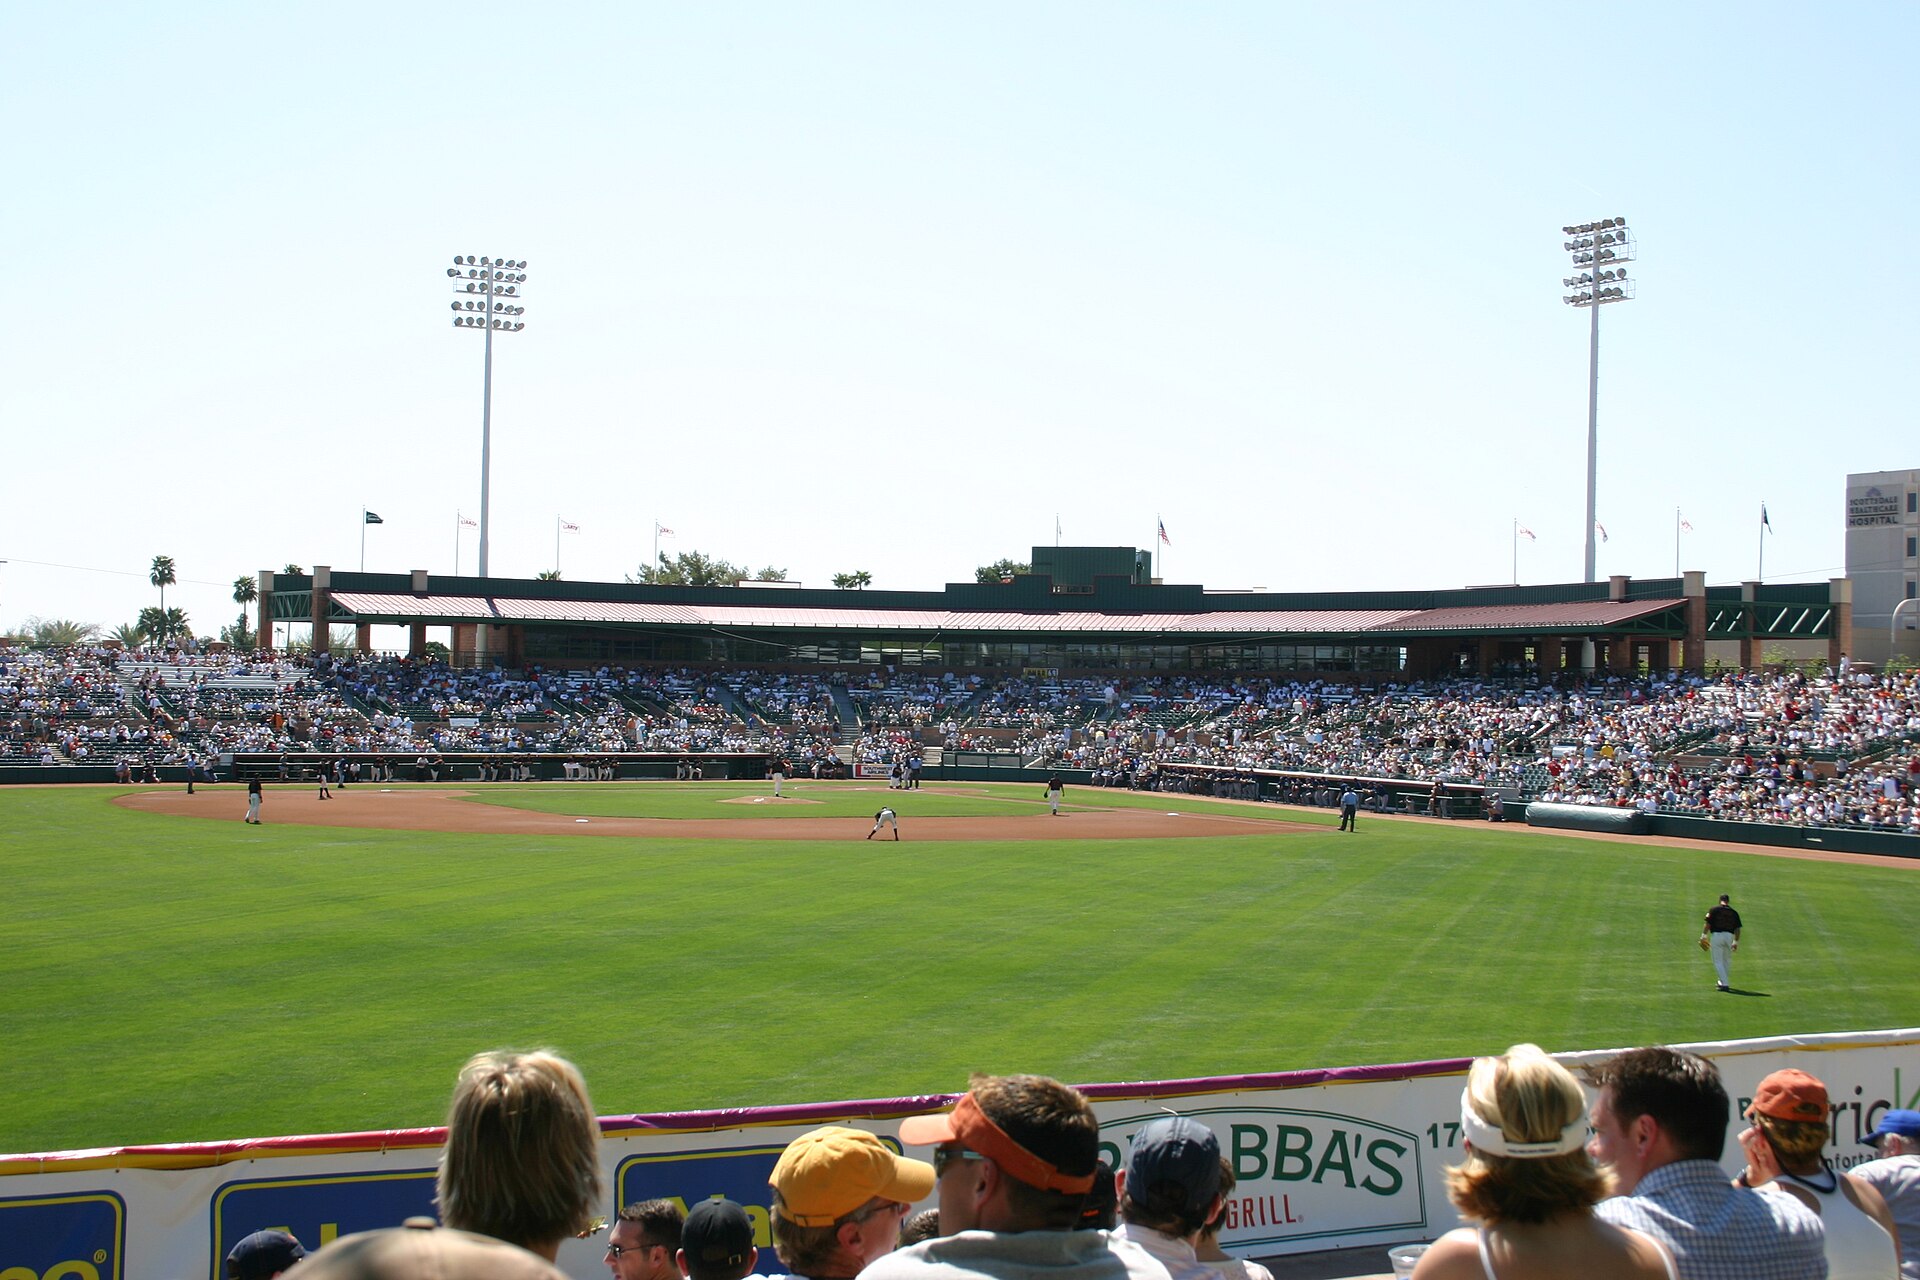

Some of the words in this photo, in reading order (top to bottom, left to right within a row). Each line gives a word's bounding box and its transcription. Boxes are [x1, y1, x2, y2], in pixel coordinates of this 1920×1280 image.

[1849, 496, 1898, 506] SCOTTSDALE
[1849, 505, 1898, 514] HEALTHCARE
[1848, 516, 1898, 526] HOSPITAL
[1426, 1122, 1465, 1148] 17
[1226, 1194, 1297, 1230] GRILL
